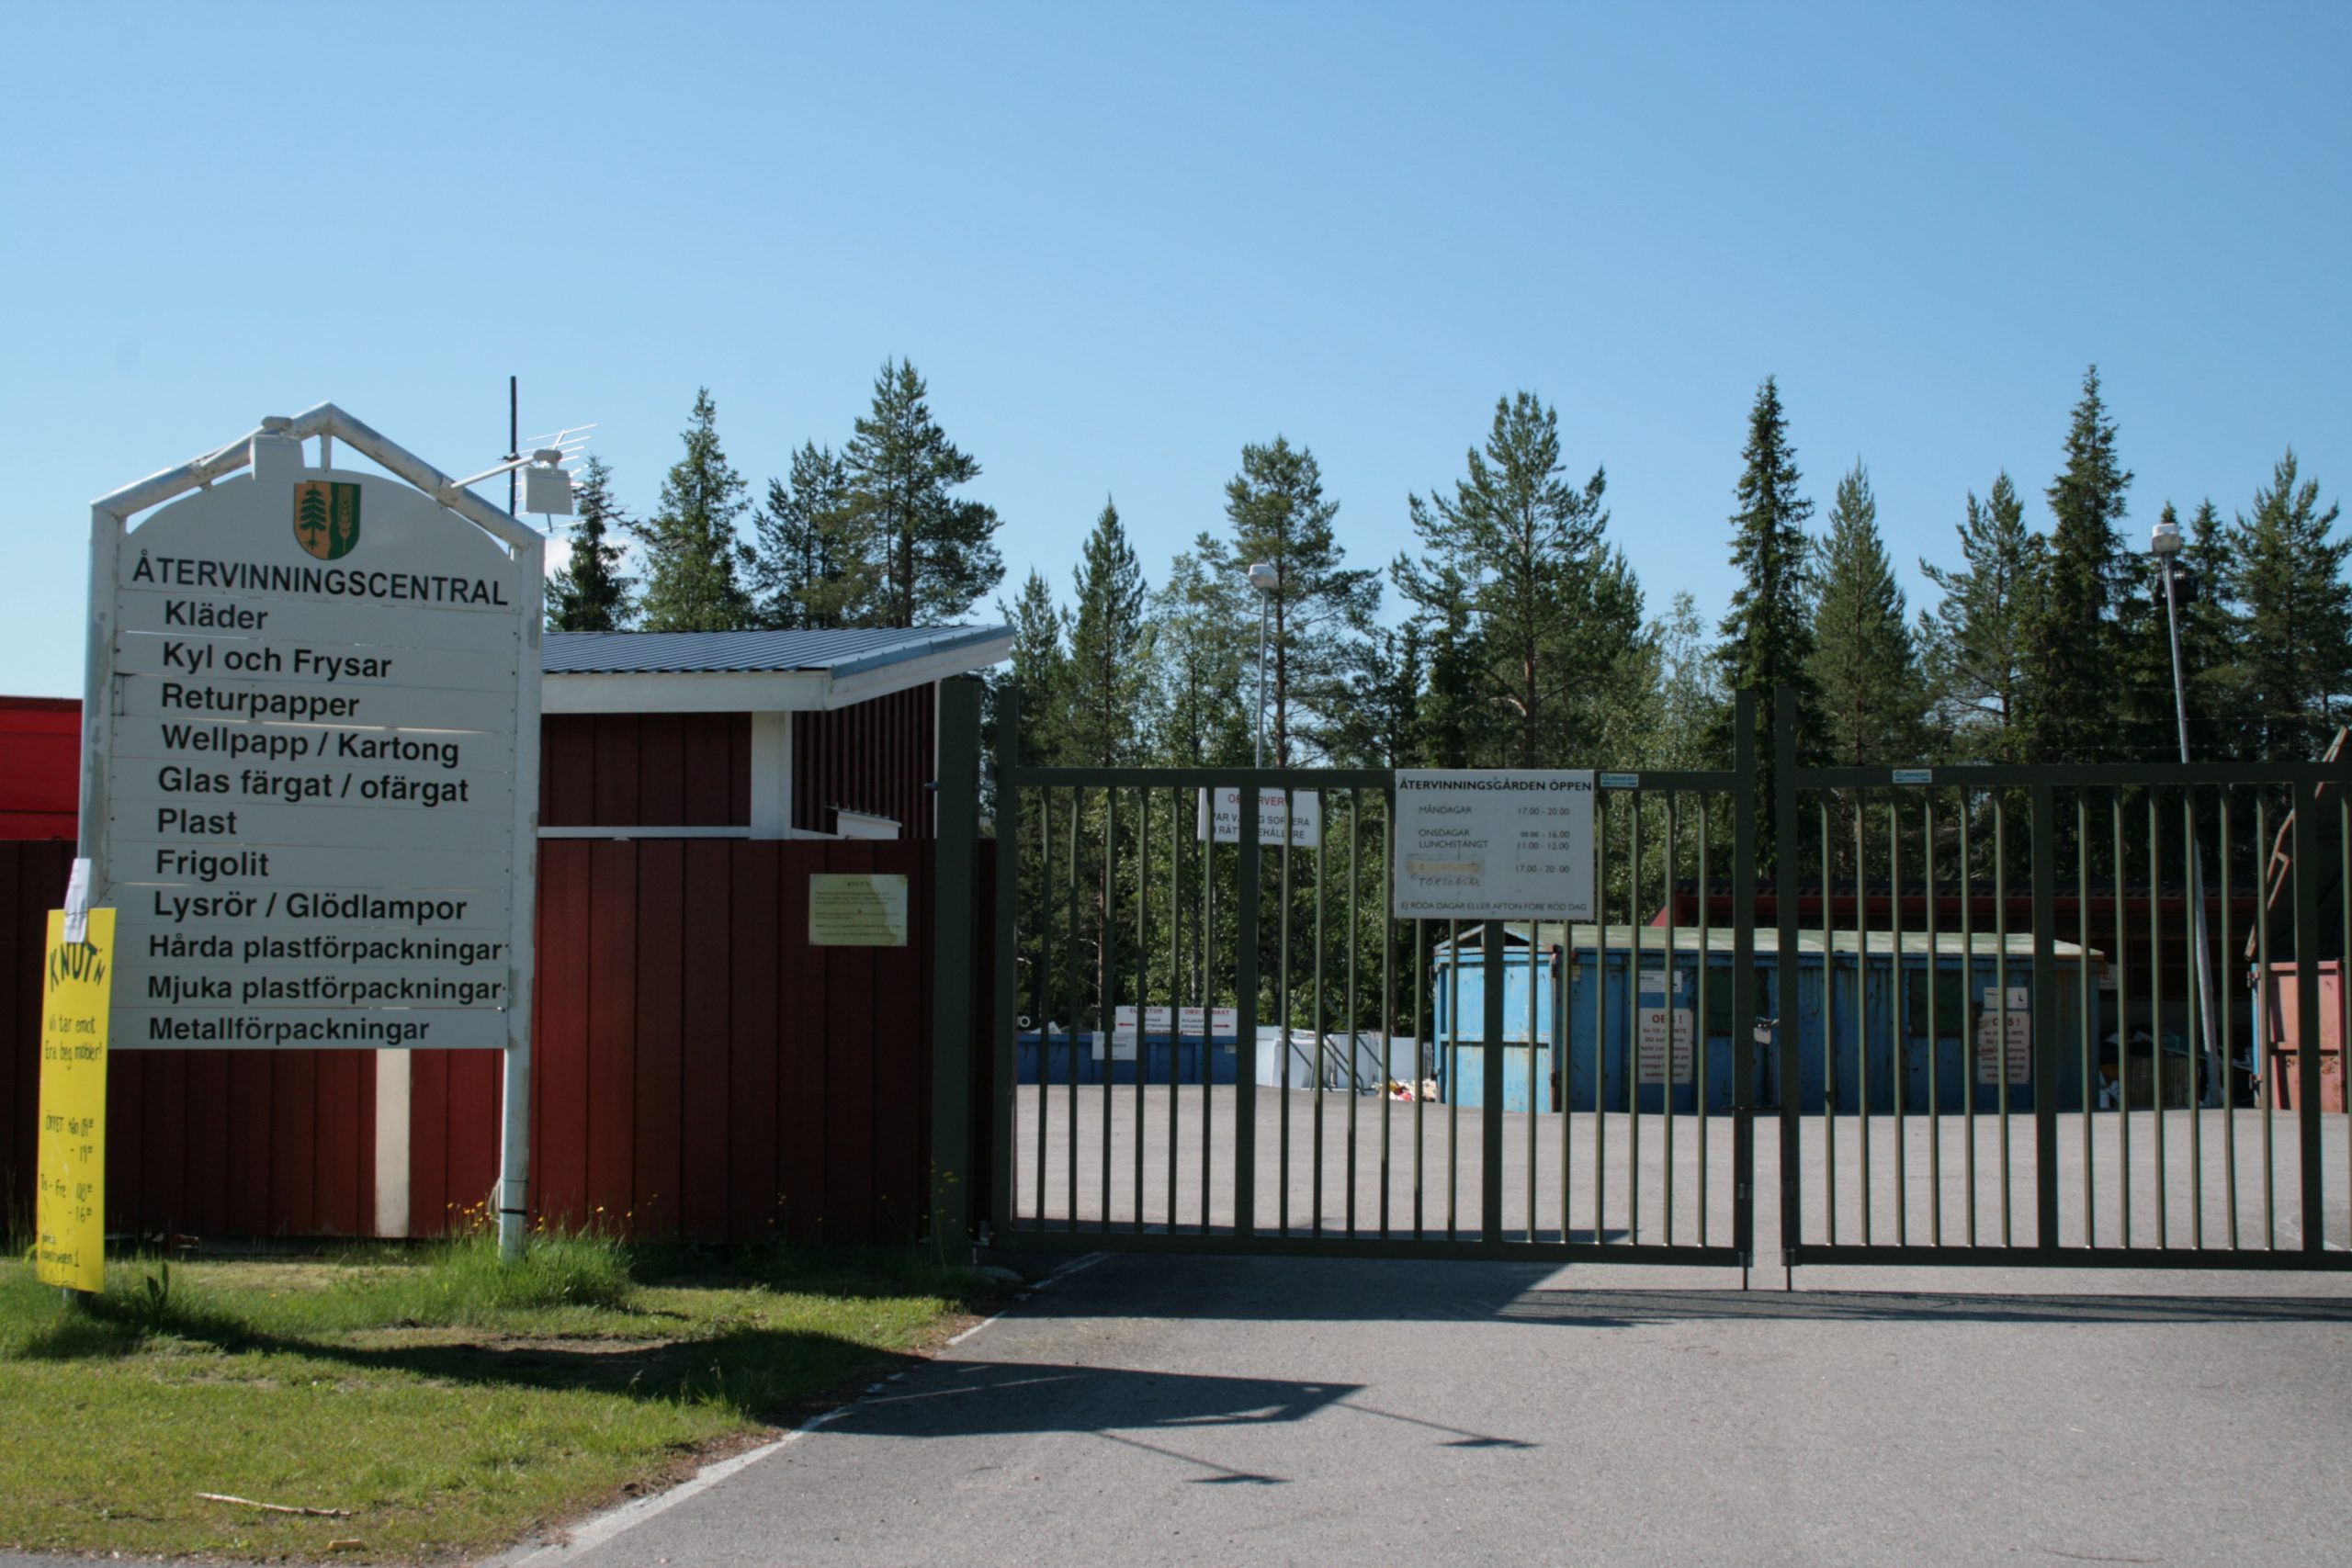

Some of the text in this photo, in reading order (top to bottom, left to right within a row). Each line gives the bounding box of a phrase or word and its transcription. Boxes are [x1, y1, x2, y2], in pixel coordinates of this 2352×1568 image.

[133, 549, 508, 606] ÅTERVINNINGSCENTRAL
[165, 601, 267, 630] Kläder
[164, 642, 391, 682] Kyl och Frysar
[162, 682, 359, 721] Returpapper
[162, 724, 458, 769] Wellpapp / Kartong
[159, 766, 468, 807] Glas färgat / ofärgat
[1399, 777, 1591, 791] ÅTERVINNINGSGÅRDEN ÖPPEN
[157, 808, 236, 835] Plast
[1419, 804, 1472, 814] MÅNDAGAR
[1519, 807, 1540, 816] 17.00
[1547, 807, 1570, 816] 20.00
[1419, 829, 1470, 838] ONSDAGAR
[1548, 830, 1570, 839] 16.00
[1548, 842, 1570, 851] 12.00
[156, 850, 268, 882] Frigolit
[154, 891, 467, 926] Lysrör / Glödlampor
[1436, 902, 1465, 910] DAGAR
[150, 933, 502, 965] Hårda plastförpackningar
[149, 976, 502, 1005] Mjuka plastförpackningar
[150, 1018, 429, 1045] Metallförpackningar
